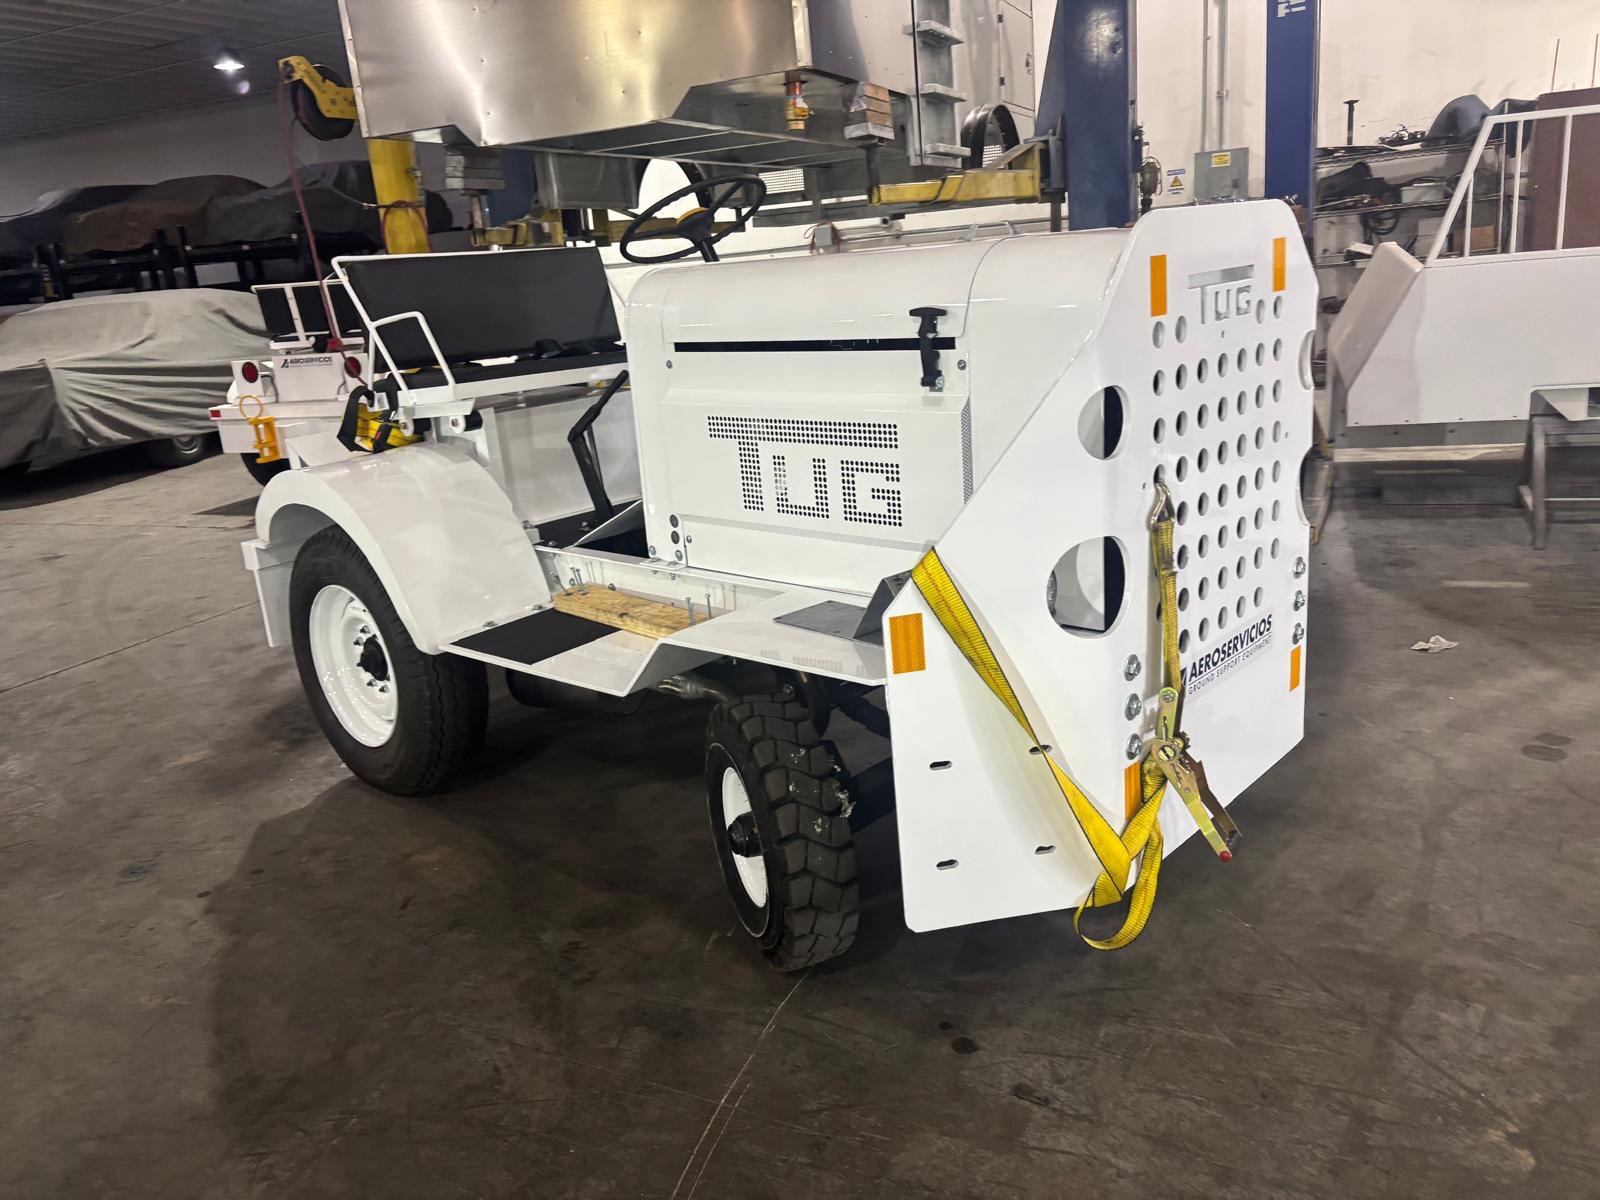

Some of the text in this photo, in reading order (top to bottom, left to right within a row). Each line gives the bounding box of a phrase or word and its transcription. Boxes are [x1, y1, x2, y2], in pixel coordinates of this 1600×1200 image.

[1187, 264, 1255, 324] TUG
[707, 415, 902, 527] TUG
[1188, 614, 1272, 682] AEROSERVICIOS
[1188, 673, 1215, 695] GROUND
[1216, 655, 1241, 678] SUPPORT
